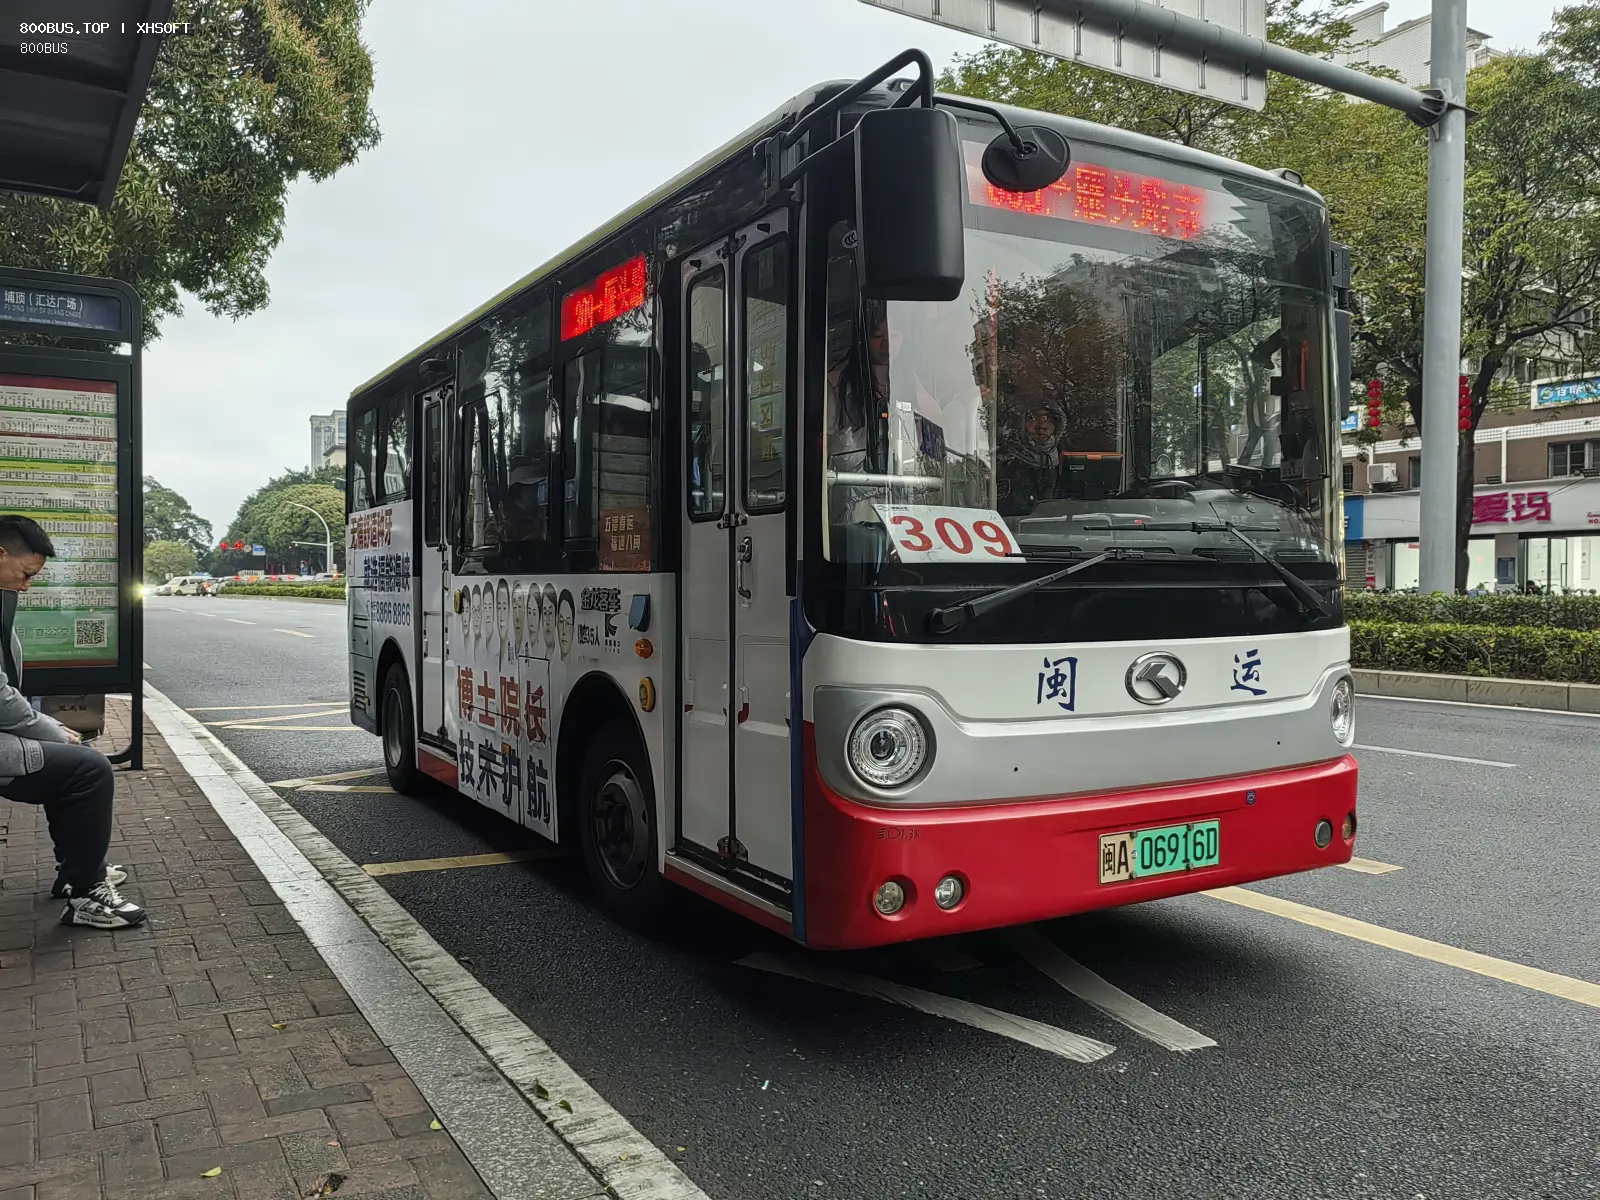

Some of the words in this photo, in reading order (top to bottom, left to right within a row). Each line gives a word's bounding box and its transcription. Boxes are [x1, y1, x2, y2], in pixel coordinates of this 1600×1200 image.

[889, 515, 1013, 558] 309
[393, 602, 411, 627] 8866
[580, 586, 621, 612] 金龙客车
[1037, 656, 1079, 712] 闽
[1230, 648, 1267, 696] 运
[457, 665, 547, 744] 博士院长
[1102, 840, 1130, 877] 闽A
[1140, 827, 1218, 871] 06916D
